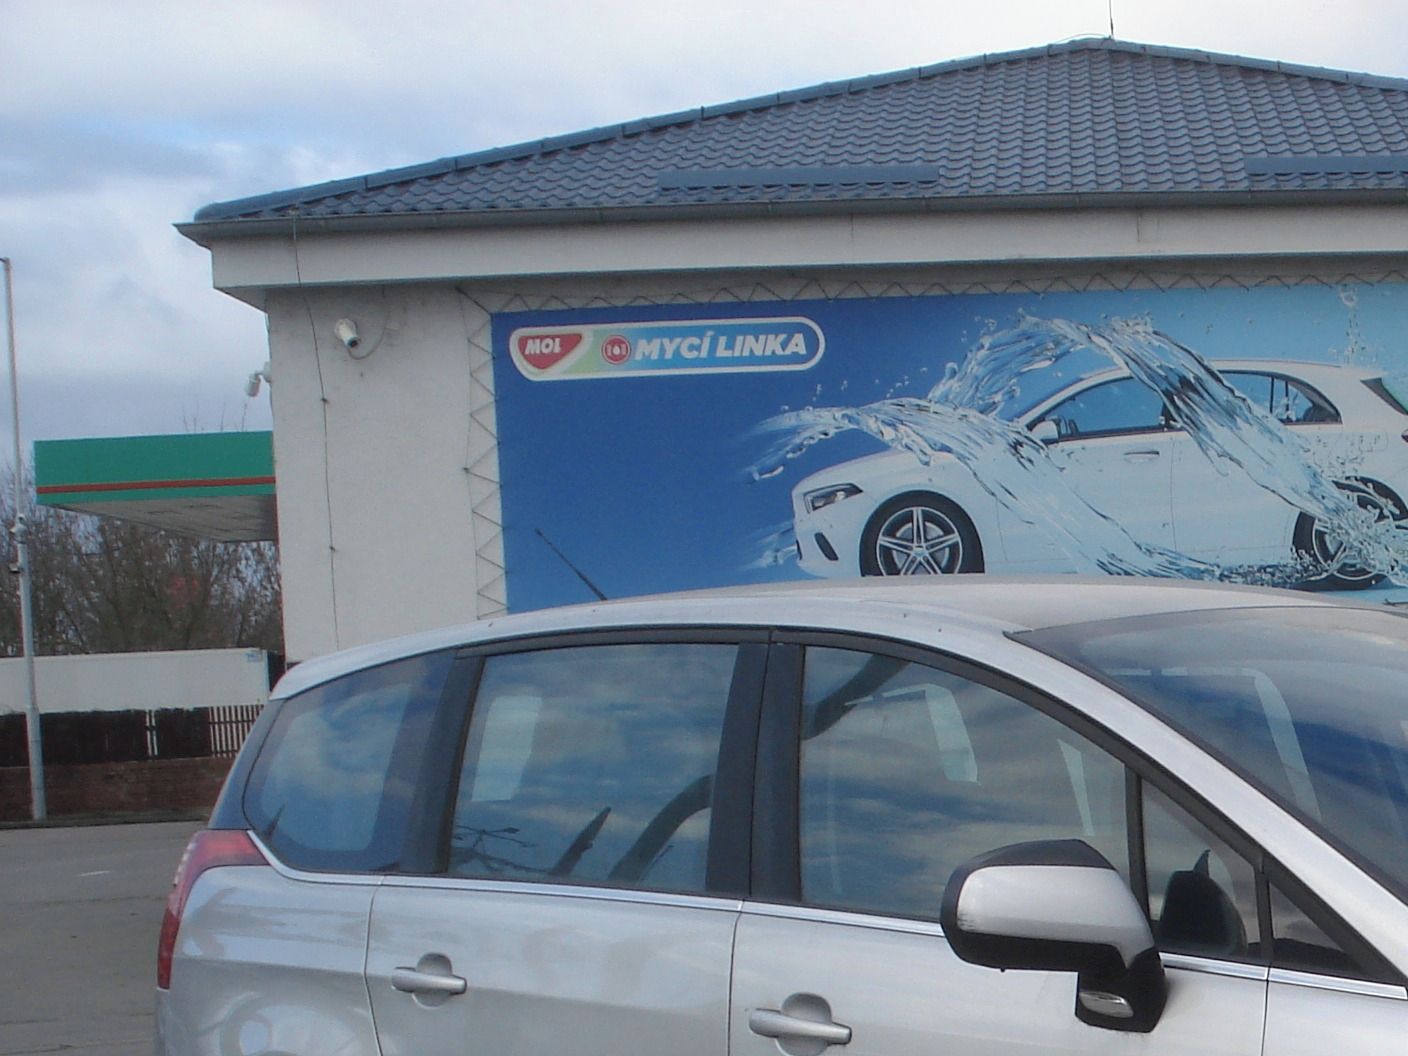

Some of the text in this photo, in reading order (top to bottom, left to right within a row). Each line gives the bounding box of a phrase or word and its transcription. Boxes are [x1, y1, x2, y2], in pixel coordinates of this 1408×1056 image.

[524, 337, 562, 355] MOL
[635, 331, 807, 360] MYCÍ LINKA
